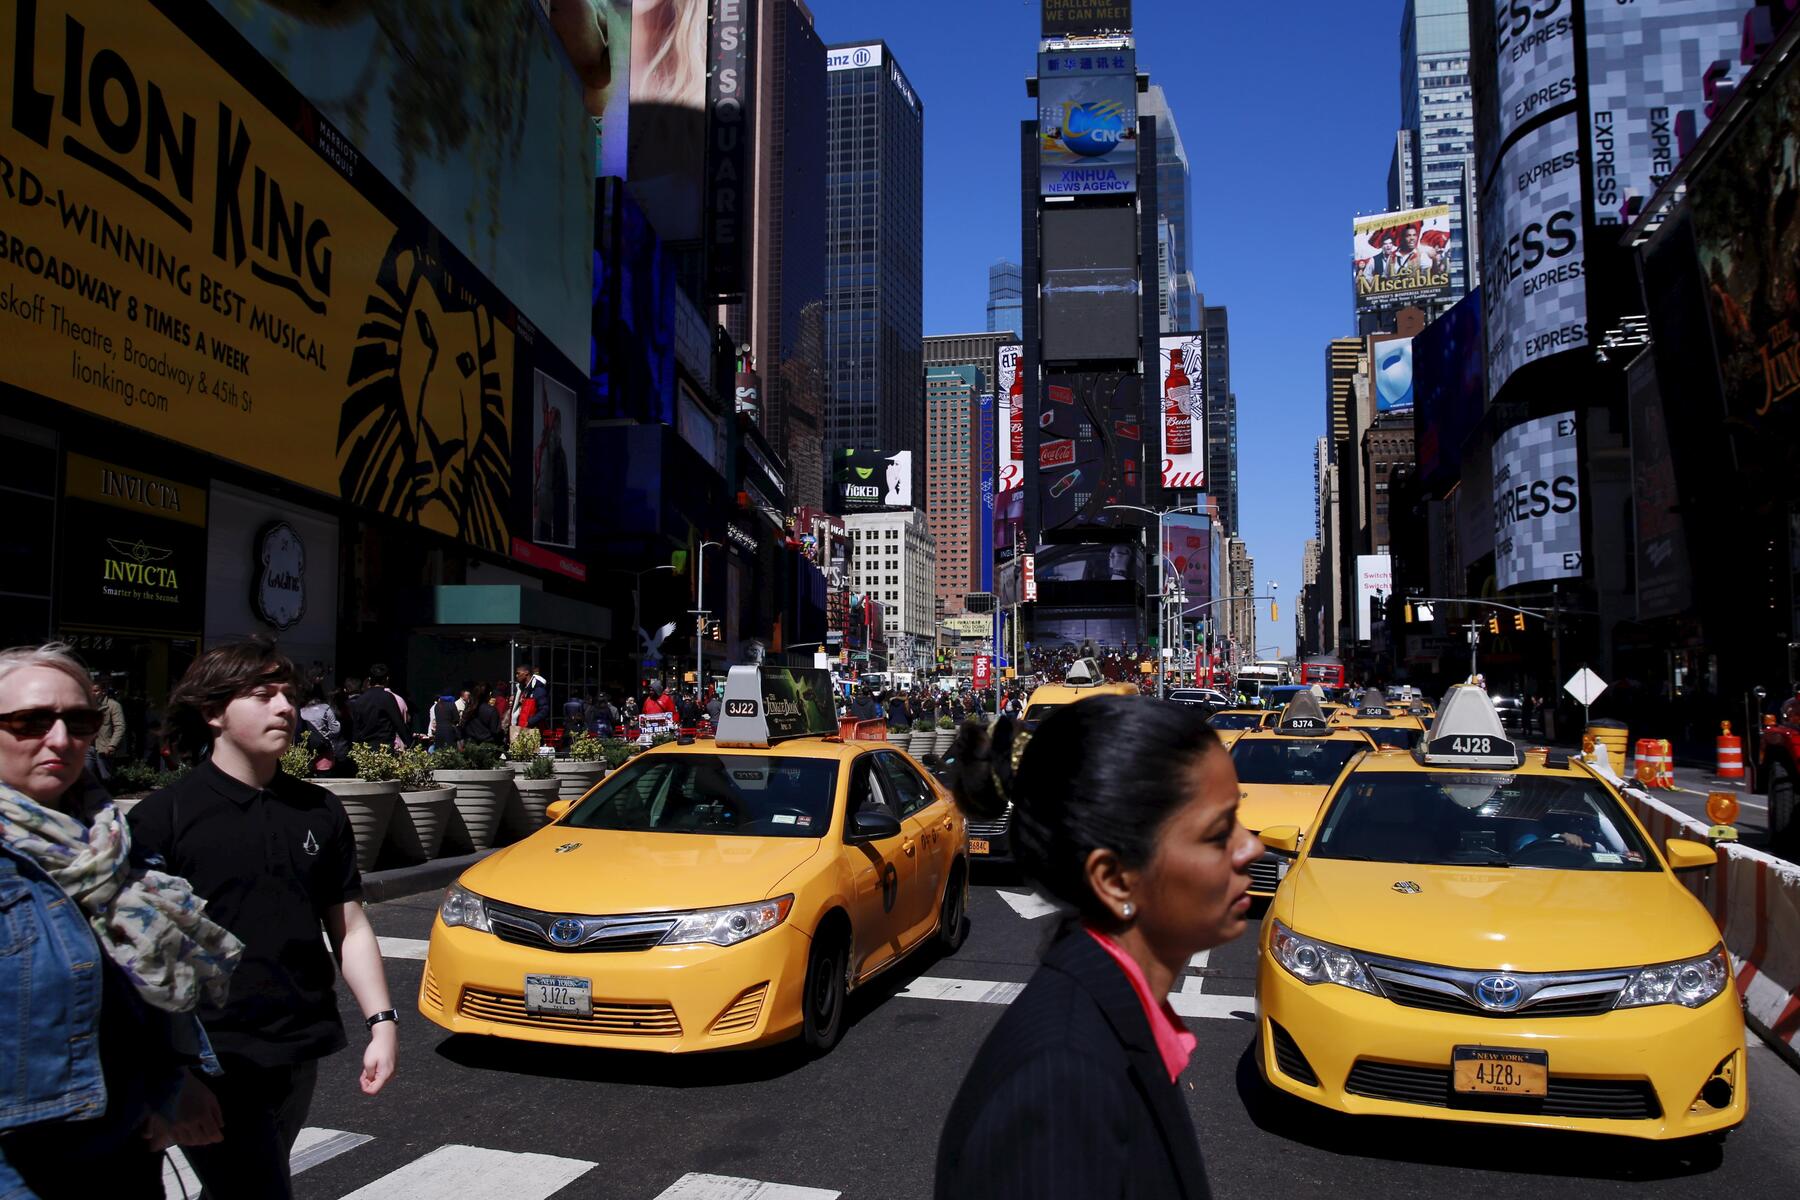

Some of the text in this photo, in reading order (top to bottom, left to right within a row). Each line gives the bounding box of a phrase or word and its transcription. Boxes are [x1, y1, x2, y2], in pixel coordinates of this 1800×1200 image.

[1046, 6, 1128, 21] WE CAN MEET
[12, 0, 332, 297] LION KING
[319, 121, 360, 161] MARRIOTT
[714, 68, 742, 244] SQUARE
[318, 138, 354, 178] MARQUIS
[1594, 111, 1617, 206] EXPRESS
[1049, 180, 1130, 192] NEWS AGENCY
[1062, 169, 1117, 181] XINHUA
[1390, 264, 1413, 277] Les
[0, 230, 250, 376] BROADWAY 8 TIMES A WEEK
[200, 274, 245, 322] BEST
[249, 305, 327, 371] MUSICAL
[1768, 318, 1792, 350] THE
[51, 303, 117, 360] Theatre,
[124, 337, 194, 394] Broadway
[198, 371, 208, 394] &
[211, 380, 238, 407] 45th
[242, 390, 253, 414] St
[72, 350, 168, 413] lionking.com
[981, 409, 993, 472] NOVOTEL
[101, 469, 180, 512] INVICTA
[103, 558, 178, 589] INVICTA
[1025, 557, 1037, 600] HELLO
[976, 657, 988, 677] tkts
[729, 702, 754, 714] 3J22
[1292, 720, 1314, 728] 8J74
[1452, 737, 1491, 753] 4J28
[558, 979, 577, 987] YORK
[1477, 1052, 1525, 1062] NEW YORK
[1476, 1063, 1521, 1086] 4J28J
